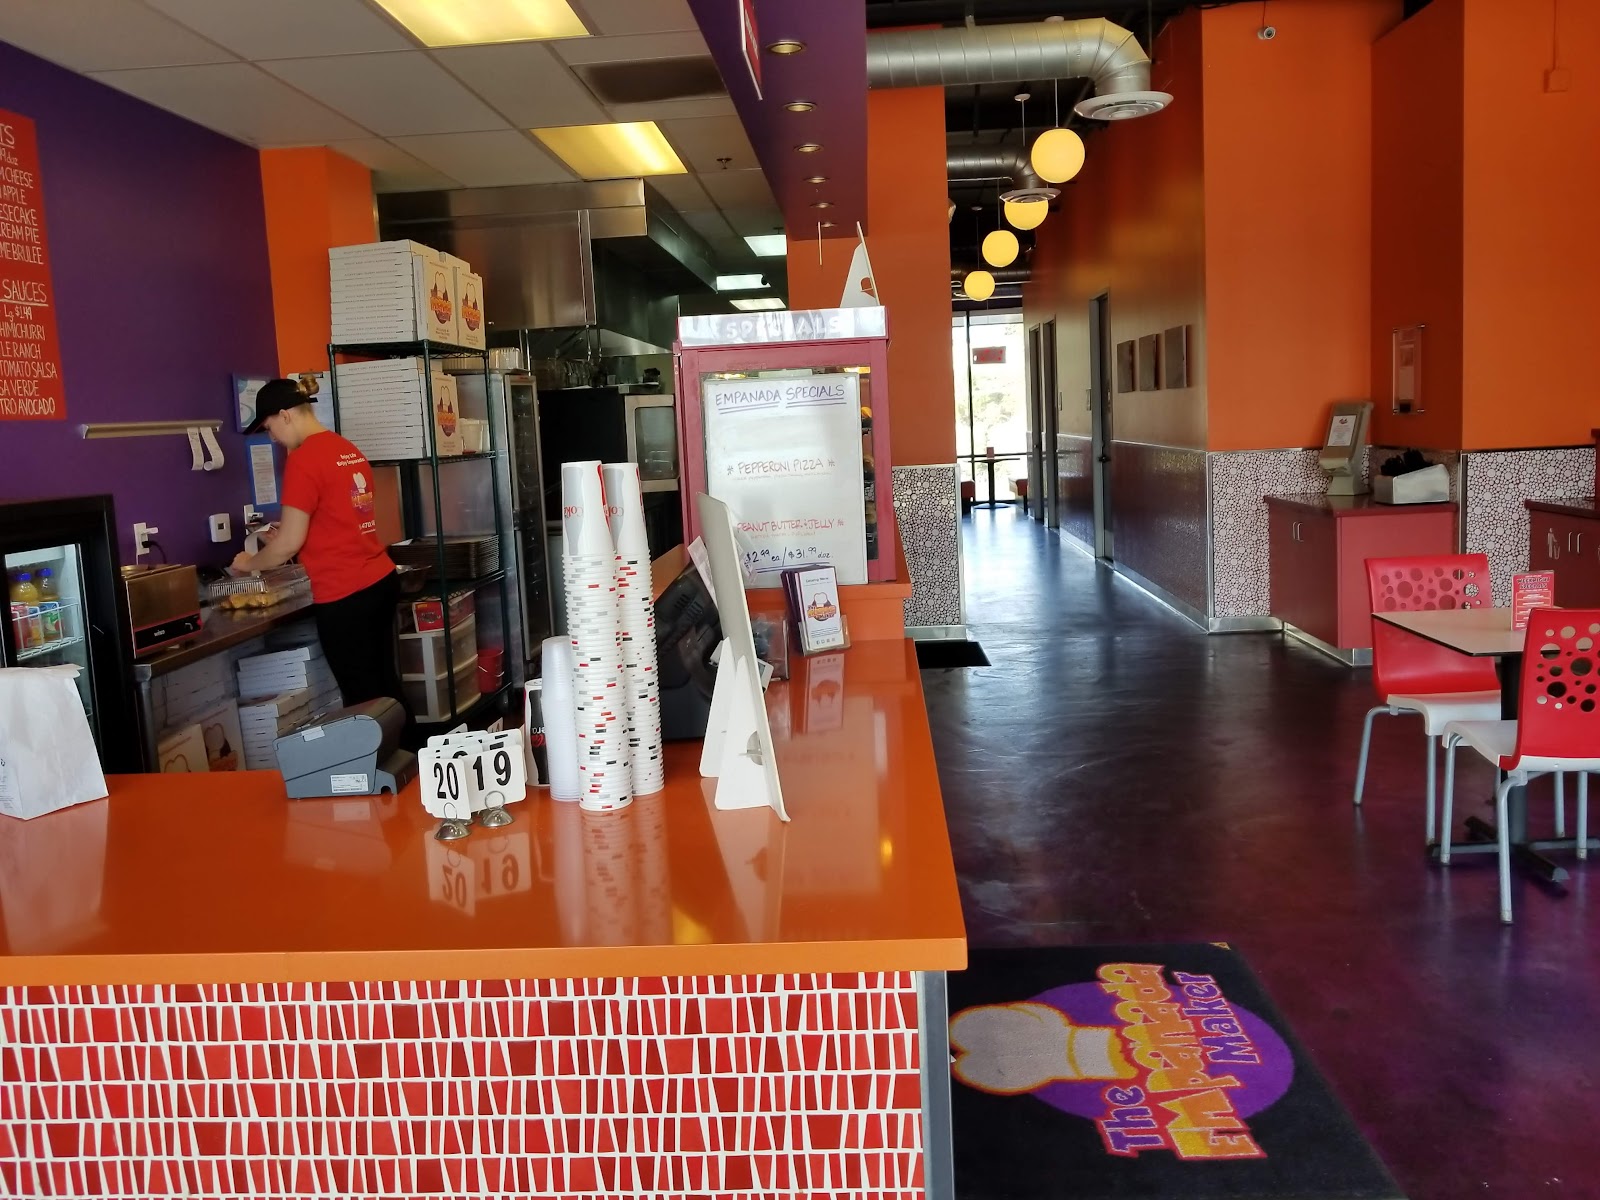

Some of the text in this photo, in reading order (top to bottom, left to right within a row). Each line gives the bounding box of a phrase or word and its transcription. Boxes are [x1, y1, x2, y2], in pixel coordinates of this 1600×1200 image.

[5, 167, 34, 189] CHEESE
[25, 226, 40, 244] PIE
[12, 242, 44, 265] BRULEE
[2, 278, 47, 303] SAUCES
[726, 317, 842, 339] SPALS
[12, 342, 42, 359] RANCH
[31, 362, 58, 379] SALSA
[10, 380, 40, 397] VERDE
[716, 384, 845, 406] EMPANADA SPECIALS
[18, 397, 56, 416] AVOCADO
[738, 458, 824, 474] PEPPERONI PIZZA
[737, 521, 770, 533] PEANUT
[772, 520, 801, 532] BUTTER
[808, 518, 834, 529] JELLY
[788, 546, 817, 560] $31.99
[434, 762, 459, 801] 20
[472, 750, 512, 791] 19
[1173, 971, 1260, 1064] Maker
[1100, 1085, 1164, 1153] The
